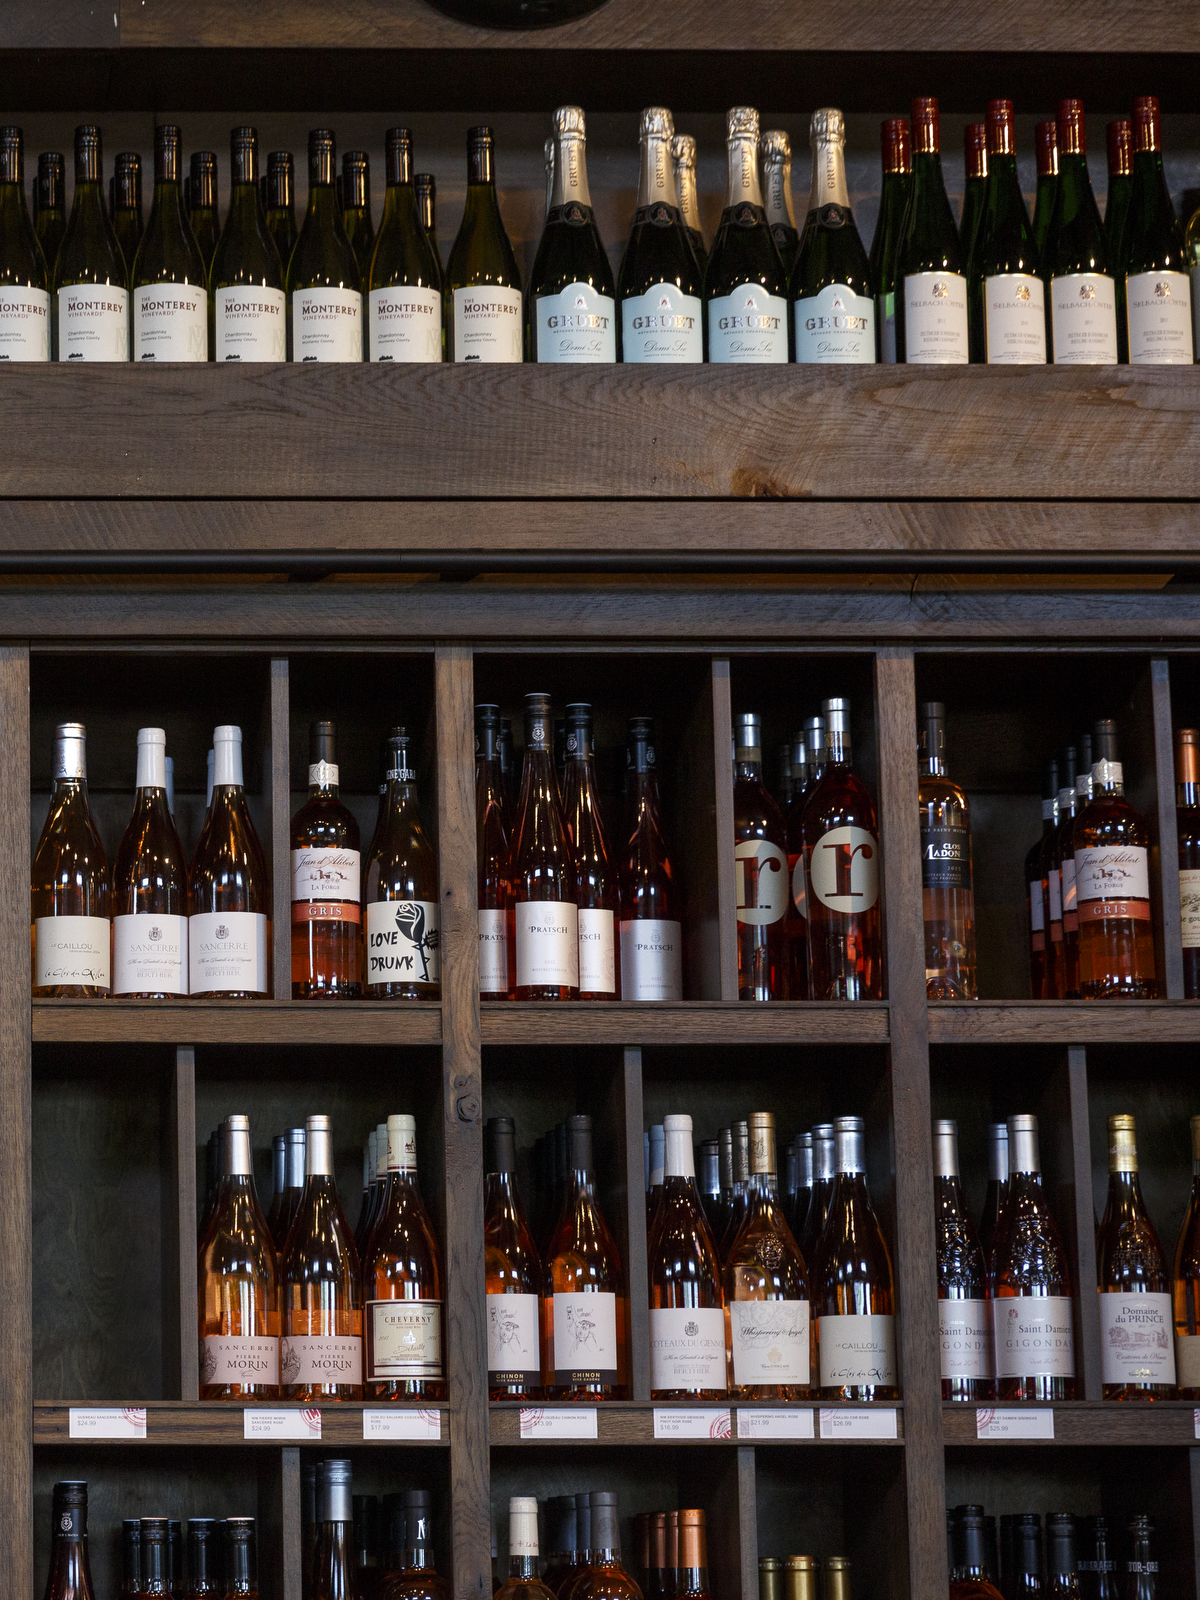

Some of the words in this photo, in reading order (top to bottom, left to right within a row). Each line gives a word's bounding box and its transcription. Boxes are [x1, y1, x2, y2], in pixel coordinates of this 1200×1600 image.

[67, 302, 123, 313] MONTEREY
[141, 301, 197, 312] MONTEREY
[224, 304, 280, 315] MONTEREY
[302, 305, 357, 317] MONTEREY
[378, 304, 434, 315] MONTEREY
[464, 304, 518, 316] MONTEREY
[547, 314, 610, 330] GRUET
[632, 314, 695, 330] GRUET
[718, 315, 781, 330] GRUET
[805, 315, 868, 330] GRUET
[559, 339, 586, 352] Demi
[644, 340, 670, 352] Demi
[942, 842, 961, 850] CLOS
[1103, 882, 1124, 890] FORGE
[308, 907, 342, 916] GRIS
[1093, 904, 1128, 916] GRIS
[370, 932, 398, 948] LOVE
[130, 944, 180, 953] SANCERRE
[200, 942, 248, 952] SANCERRE
[370, 955, 414, 972] DRUNK
[1122, 1307, 1159, 1315] Domaine
[384, 1316, 432, 1324] CHEVERNY
[742, 1326, 781, 1338] Whispering
[786, 1327, 804, 1338] Angel
[1018, 1325, 1042, 1334] Saint
[841, 1342, 878, 1350] CAILLOU
[226, 1360, 268, 1372] MORIN
[311, 1360, 352, 1372] MORIN
